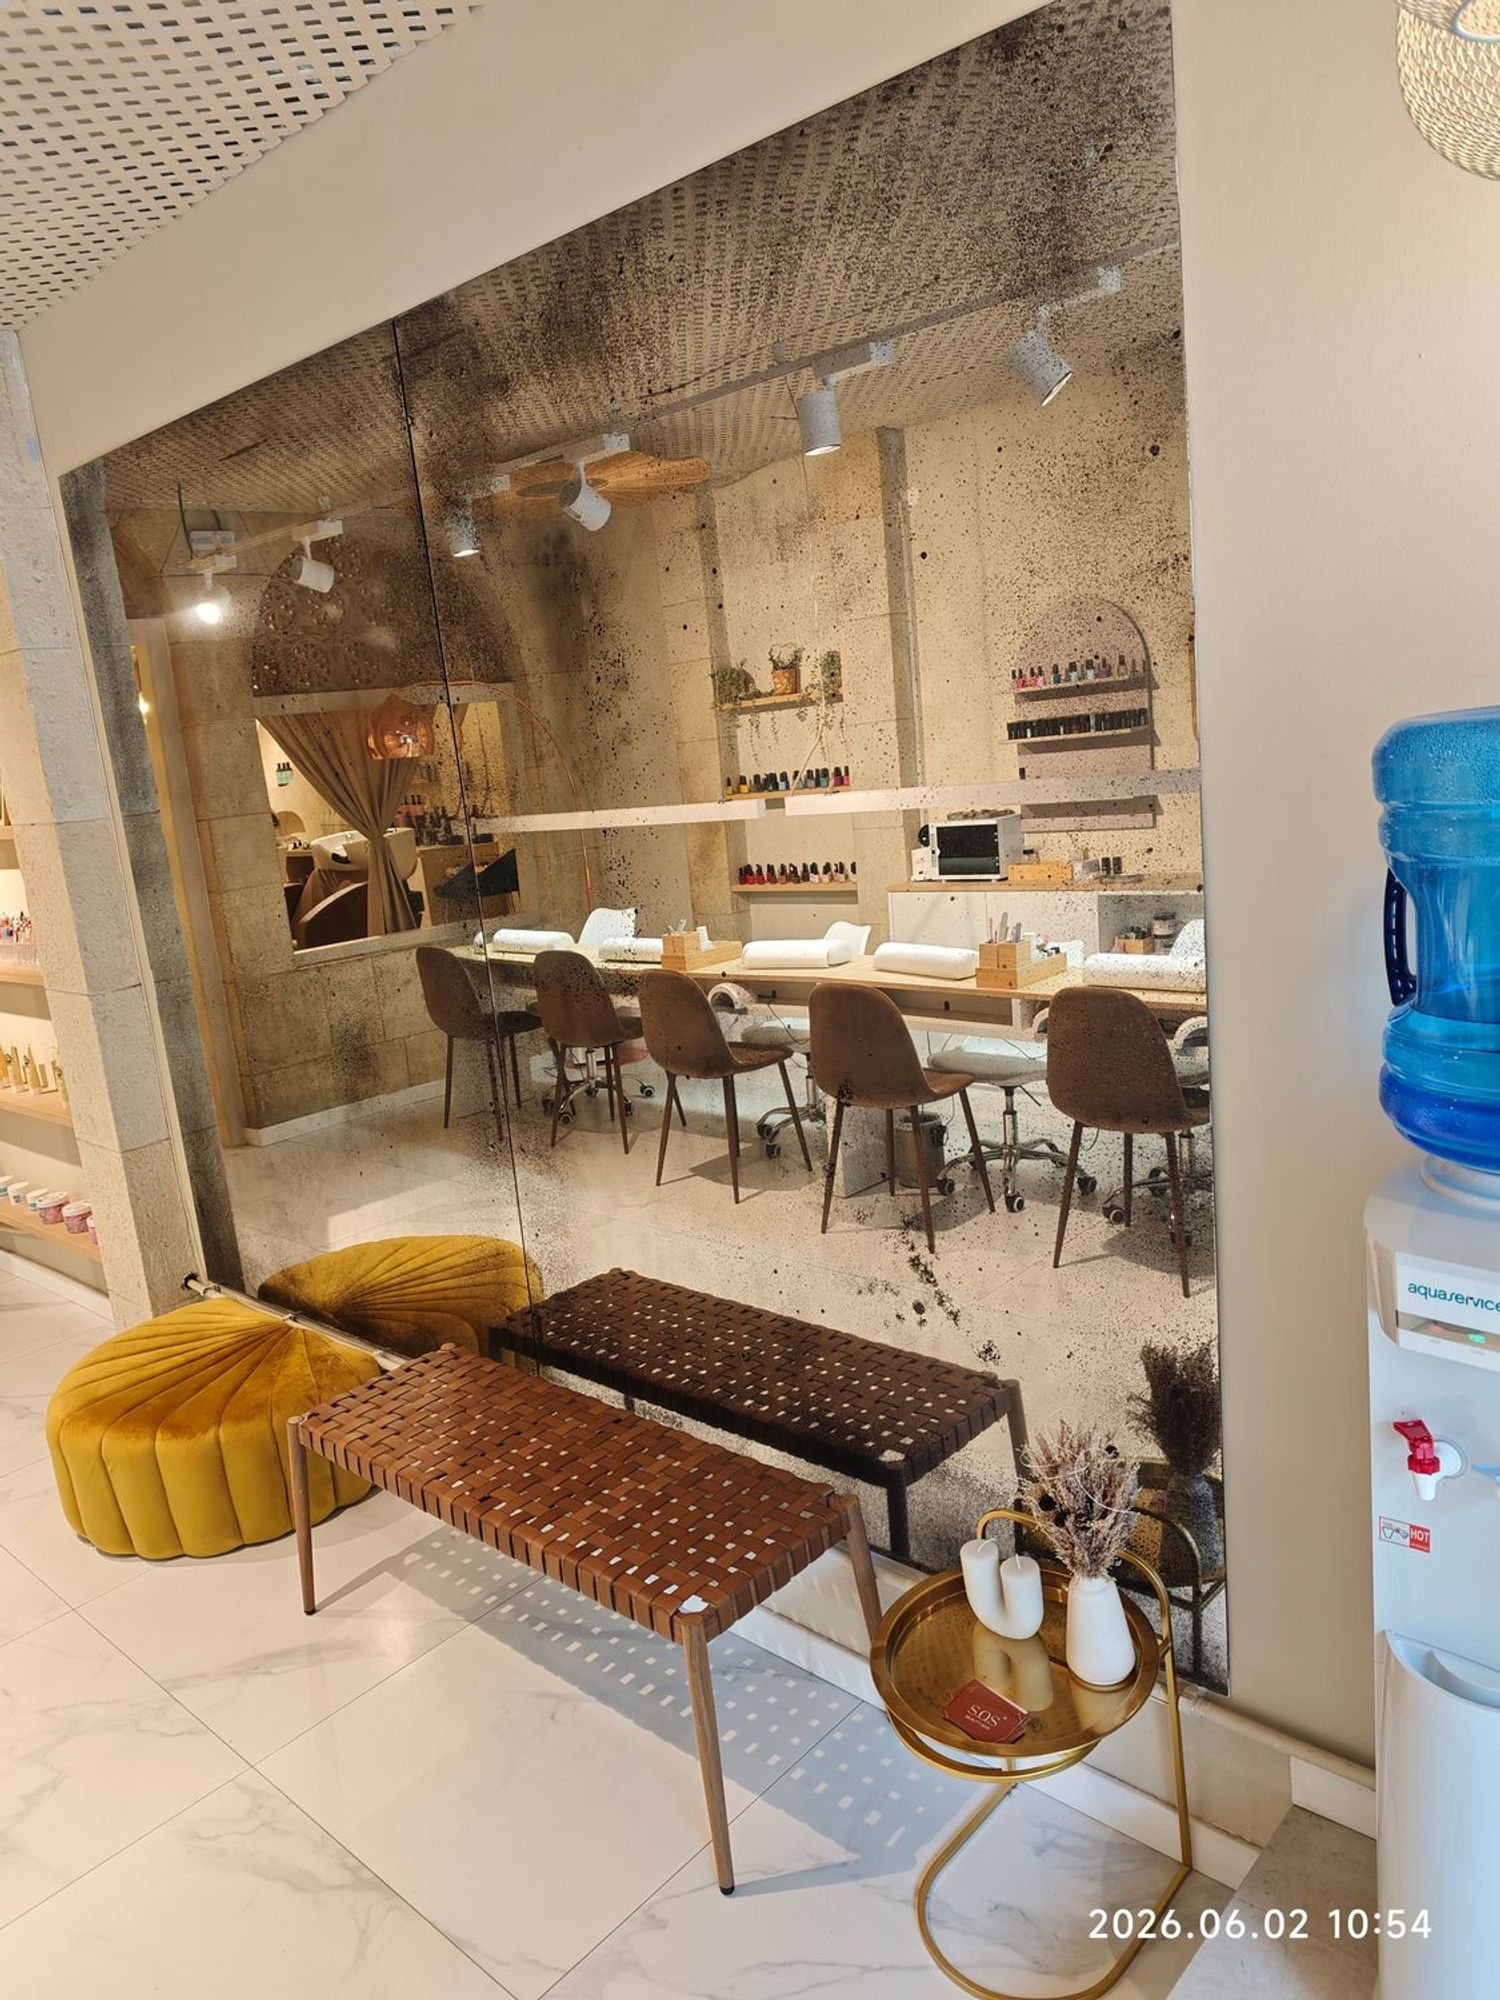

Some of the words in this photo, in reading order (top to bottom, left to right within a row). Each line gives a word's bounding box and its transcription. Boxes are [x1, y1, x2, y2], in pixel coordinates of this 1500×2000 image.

[1408, 1282, 1500, 1313] aquaservice
[1410, 1527, 1430, 1543] HOT
[967, 1704, 1000, 1727] SOS
